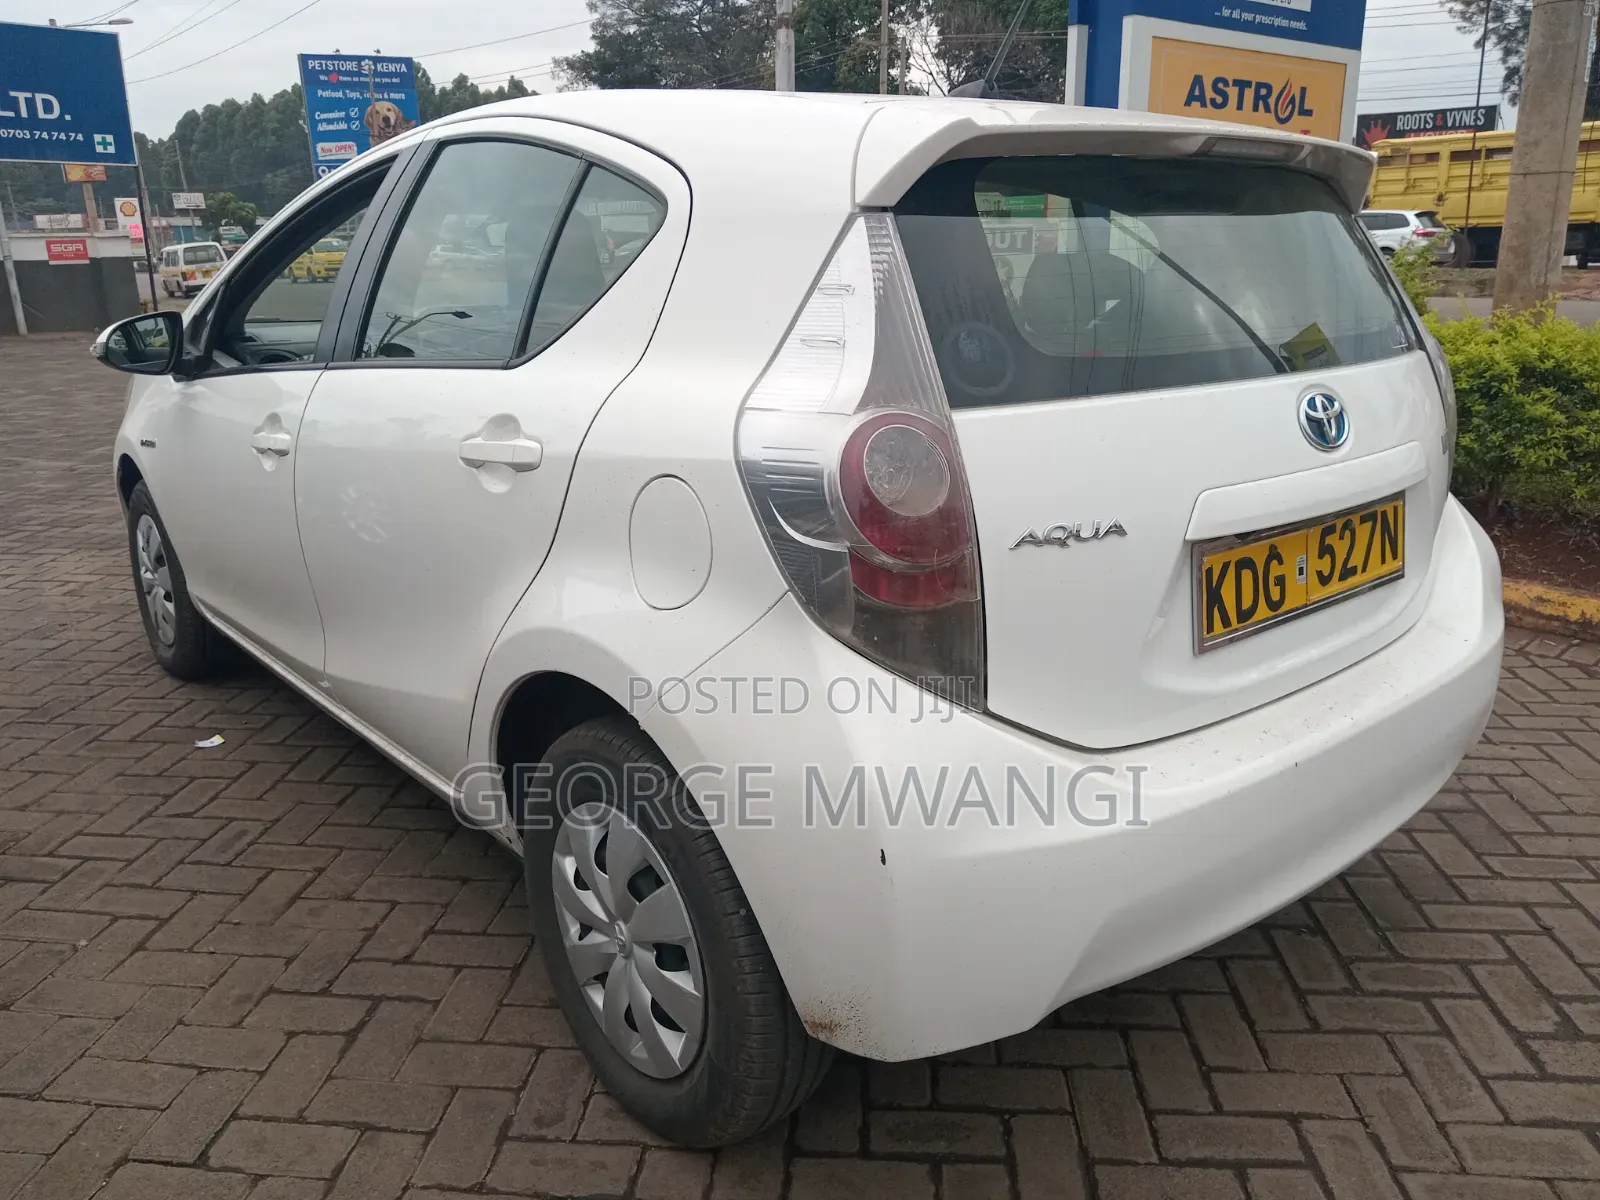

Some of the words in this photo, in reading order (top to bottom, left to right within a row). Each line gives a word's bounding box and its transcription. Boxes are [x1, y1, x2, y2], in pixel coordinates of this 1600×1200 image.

[1222, 6, 1231, 17] for
[1232, 8, 1240, 19] all
[1241, 12, 1255, 22] your
[1255, 14, 1289, 28] prescription
[1290, 20, 1308, 30] needs.
[308, 60, 358, 71] PETSTORE
[377, 62, 407, 73] KENYA
[317, 89, 345, 99] Petfood,
[345, 90, 362, 100] Toys,
[1184, 73, 1313, 124] ASTROL
[1396, 112, 1434, 131] ROOTS
[1435, 112, 1444, 126] &
[1446, 108, 1486, 127] VYNES
[0, 129, 30, 139] 0703
[34, 131, 49, 140] 74
[51, 132, 66, 141] 74
[68, 133, 84, 141] 74
[50, 243, 84, 252] SGA
[1008, 517, 1128, 550] AQUA
[1205, 545, 1286, 635] KDG
[1315, 504, 1399, 588] 527N
